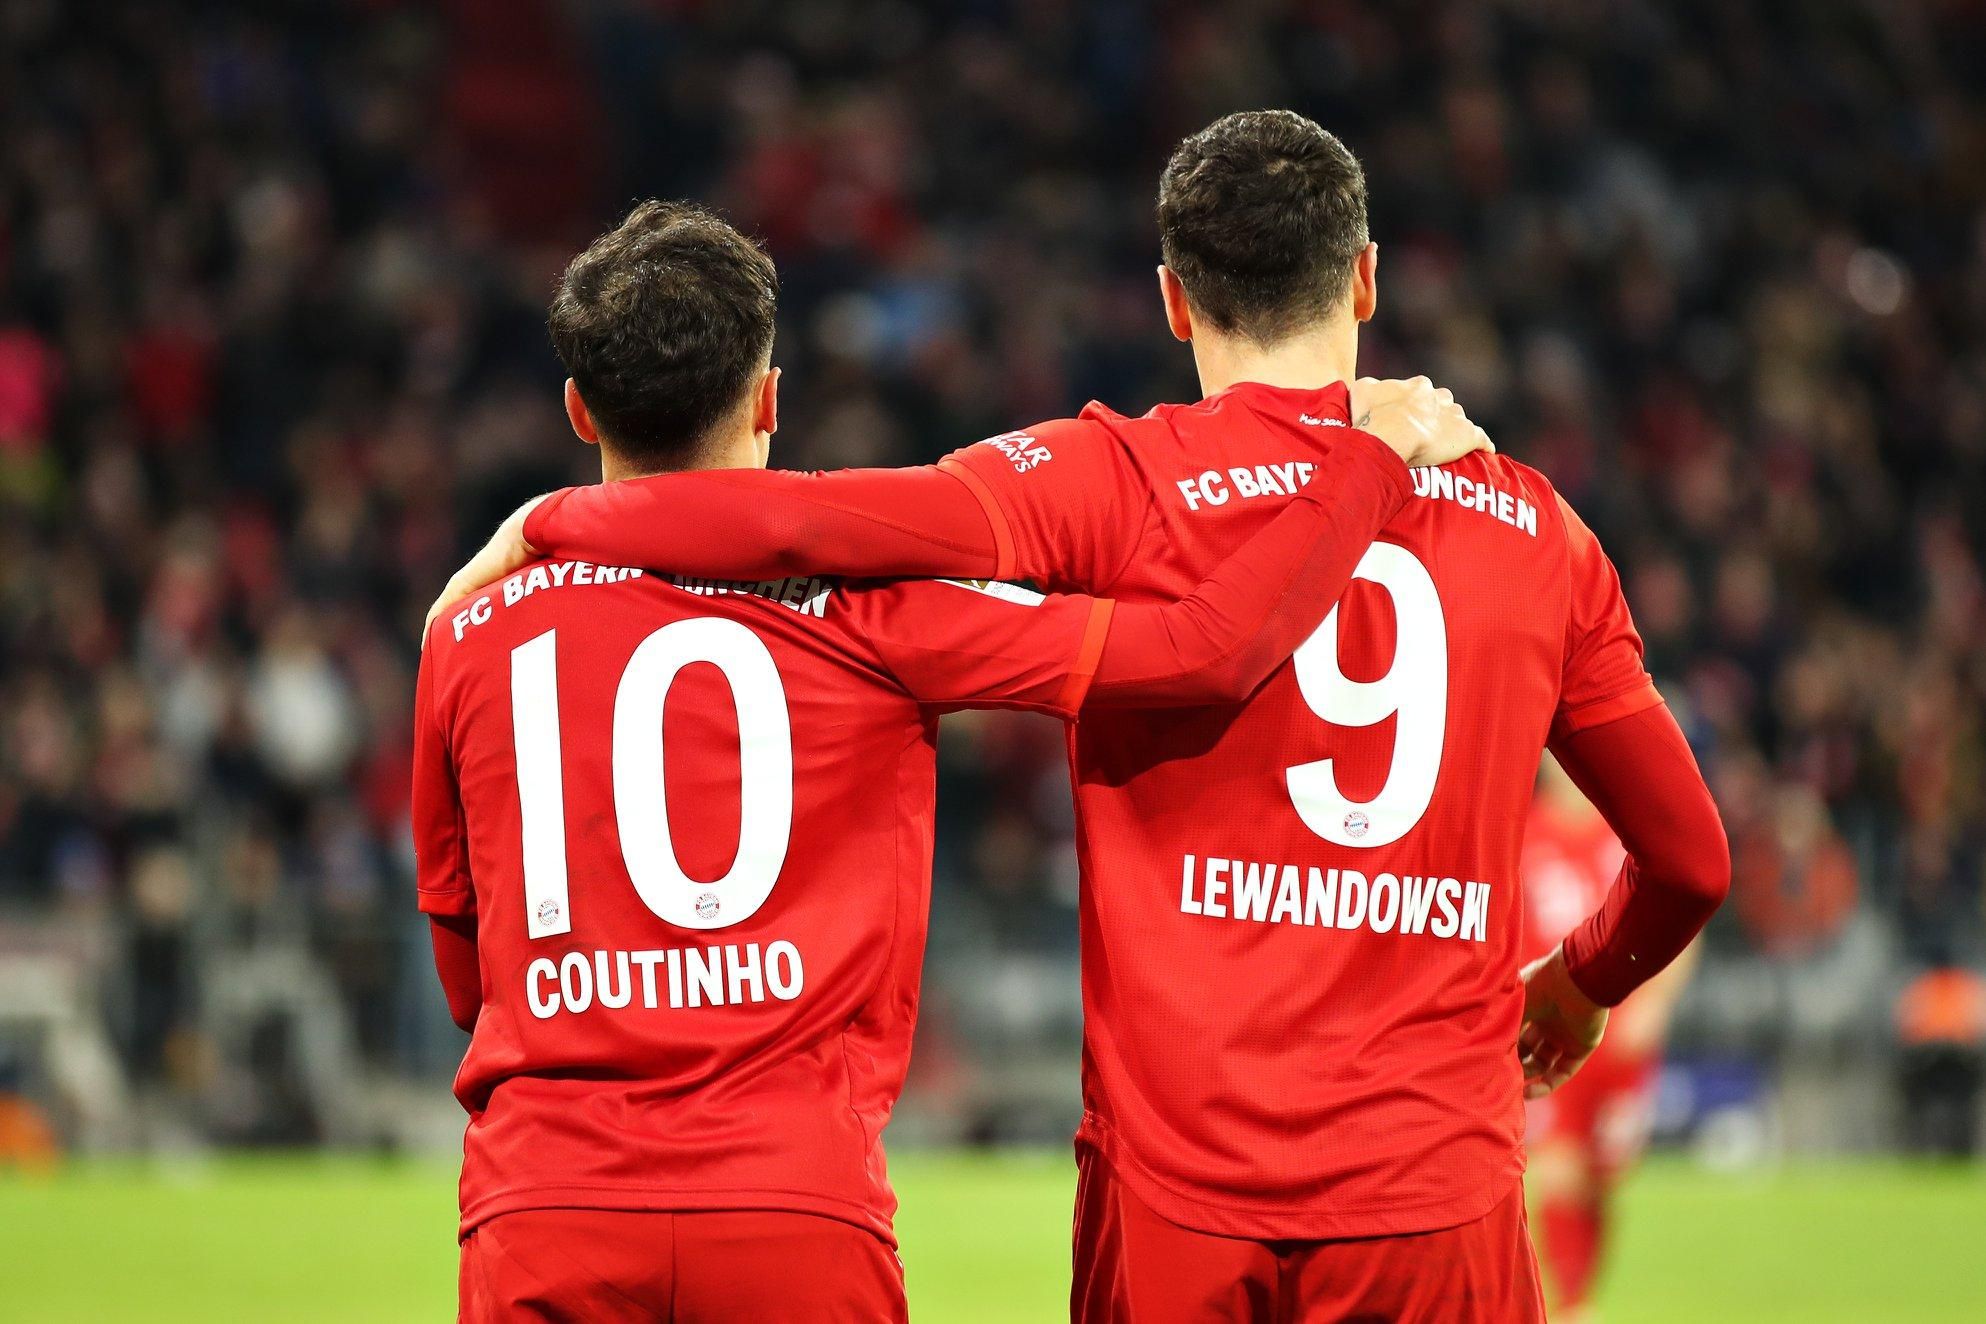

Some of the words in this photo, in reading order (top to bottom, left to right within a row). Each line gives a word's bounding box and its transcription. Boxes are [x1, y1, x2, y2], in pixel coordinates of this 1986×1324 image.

[999, 431, 1053, 468] TAR
[1176, 470, 1229, 511] FC
[1228, 461, 1319, 499] BAYE
[451, 596, 493, 643] FC
[1286, 541, 1448, 848] 9
[511, 616, 794, 939] 10
[1180, 854, 1492, 943] LEWANDOWSKI
[526, 940, 804, 1019] COUTINHO
